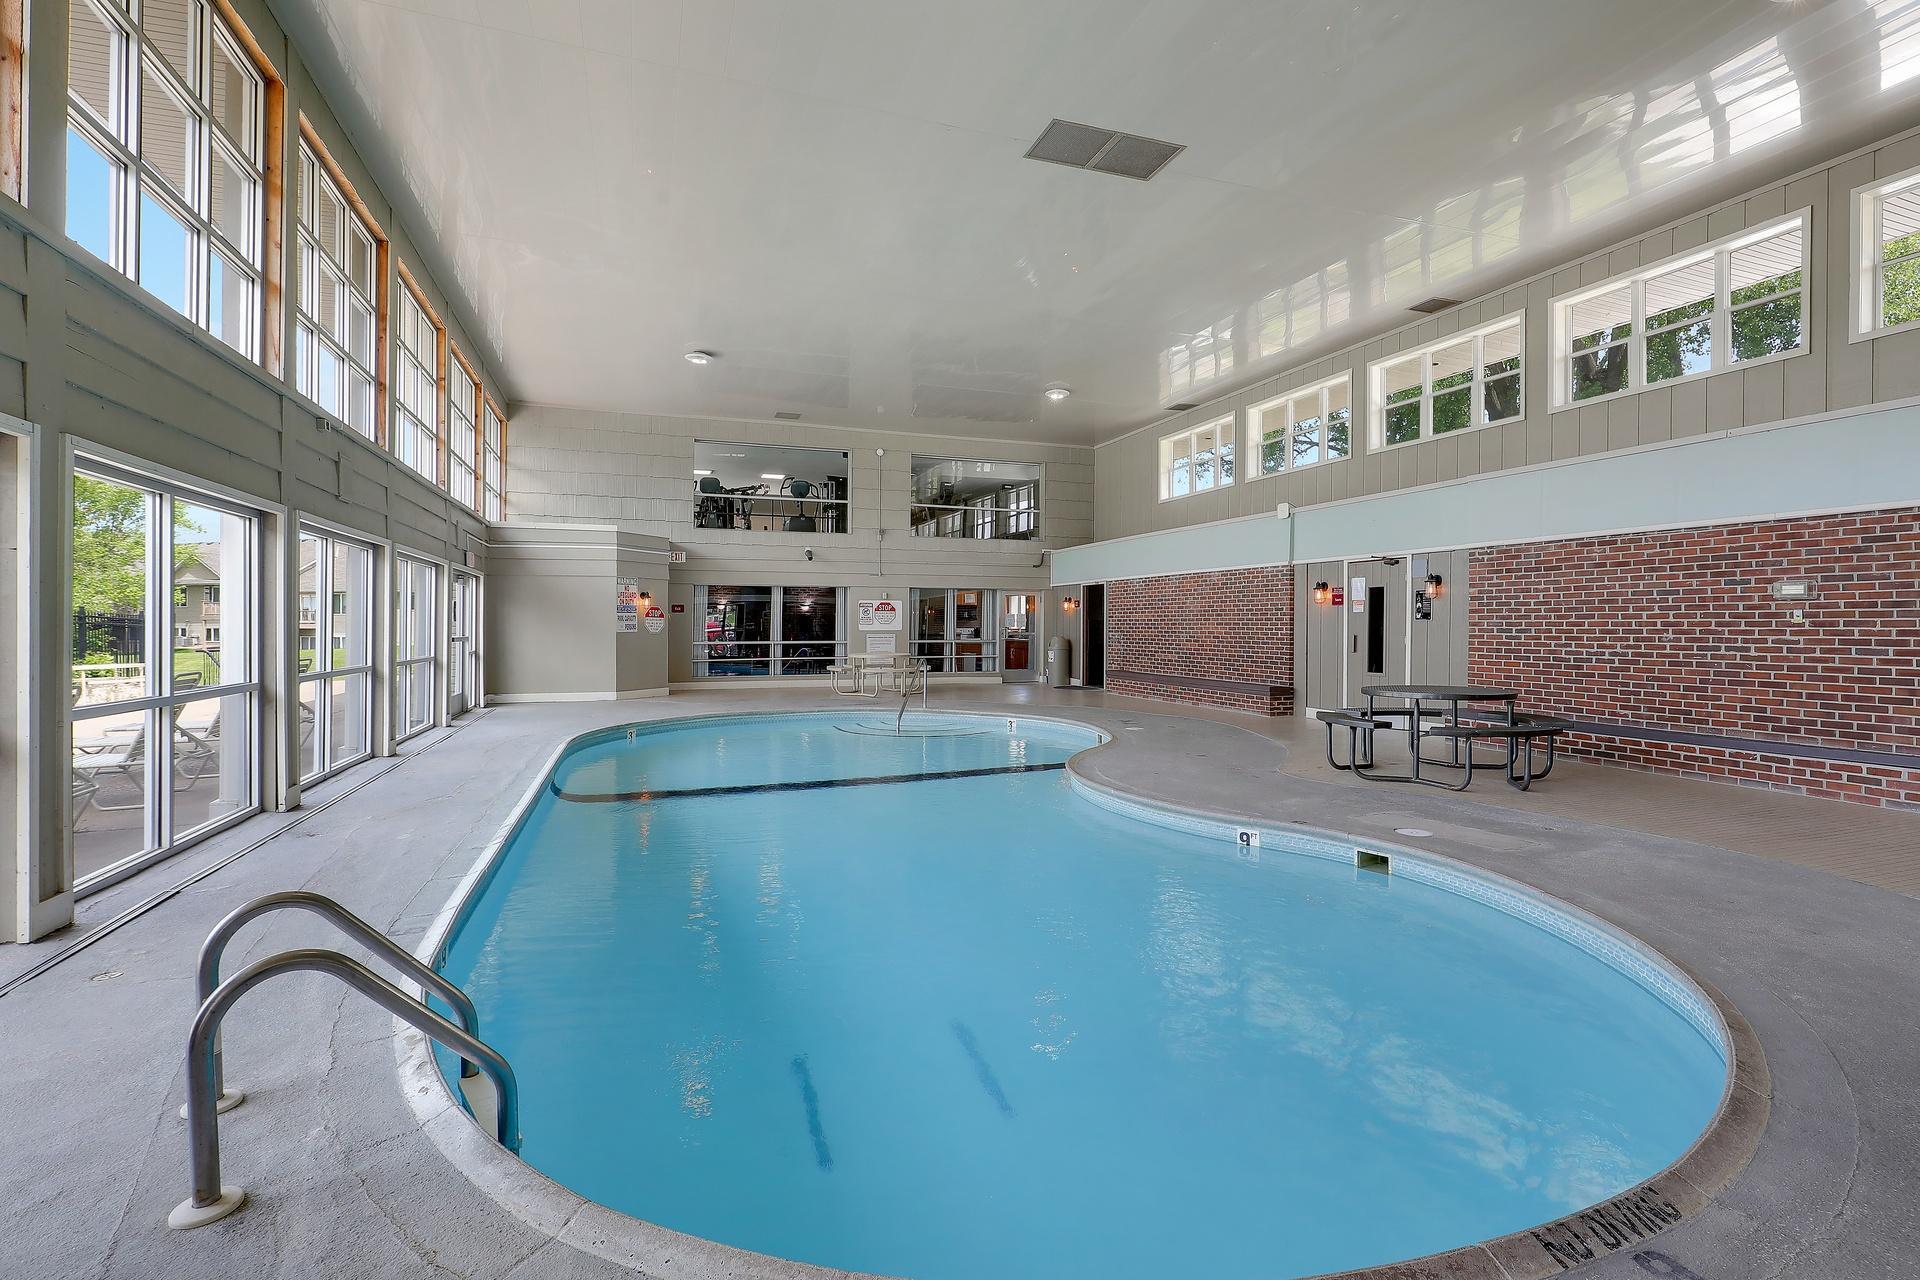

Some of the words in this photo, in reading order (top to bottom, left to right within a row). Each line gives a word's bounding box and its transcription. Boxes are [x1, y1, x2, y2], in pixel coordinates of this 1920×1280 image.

[671, 552, 683, 562] EXIT
[648, 609, 661, 617] STOP
[628, 731, 633, 740] 3
[1239, 831, 1250, 846] 9
[1530, 1222, 1596, 1269] NO
[1580, 1185, 1684, 1252] DIVING
